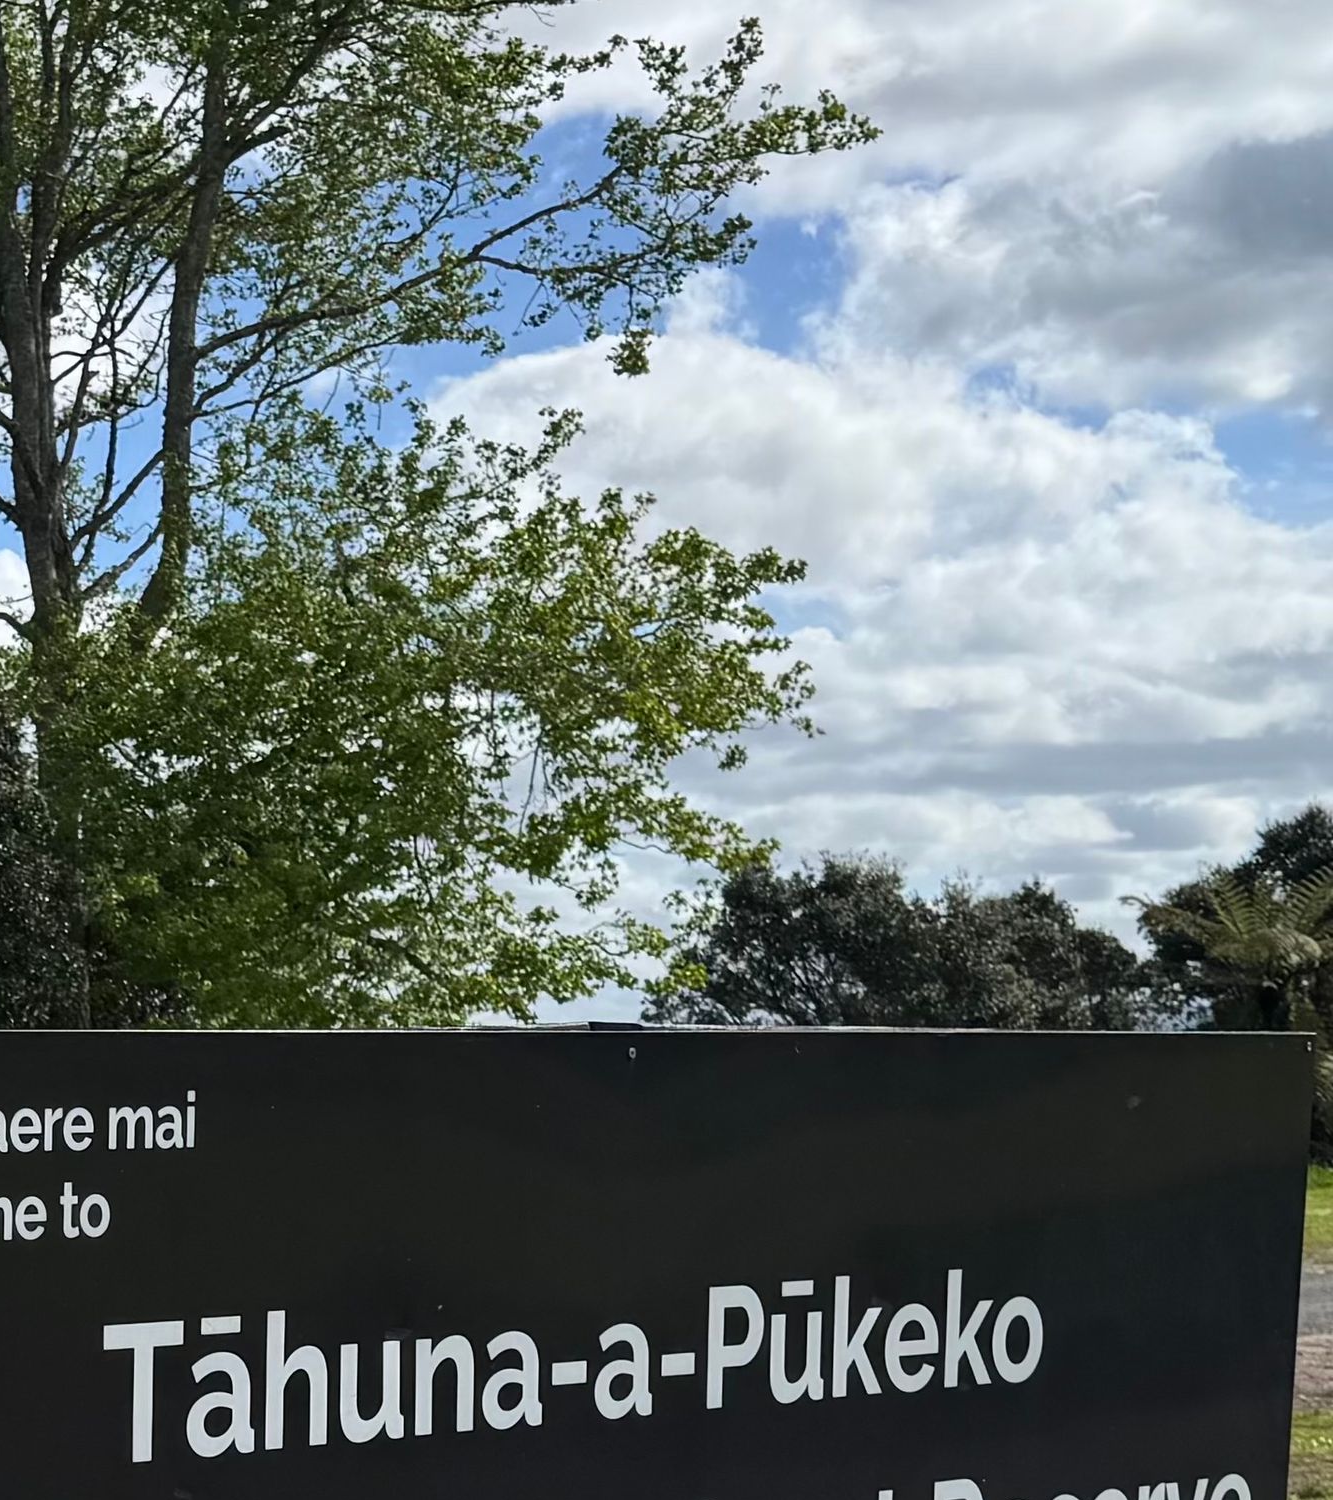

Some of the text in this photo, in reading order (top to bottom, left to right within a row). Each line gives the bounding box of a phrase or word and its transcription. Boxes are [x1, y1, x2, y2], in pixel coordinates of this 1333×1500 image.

[109, 1091, 196, 1150] mai
[60, 1182, 111, 1239] to
[104, 1269, 1043, 1462] Tāhuna-a-Pūkeko
